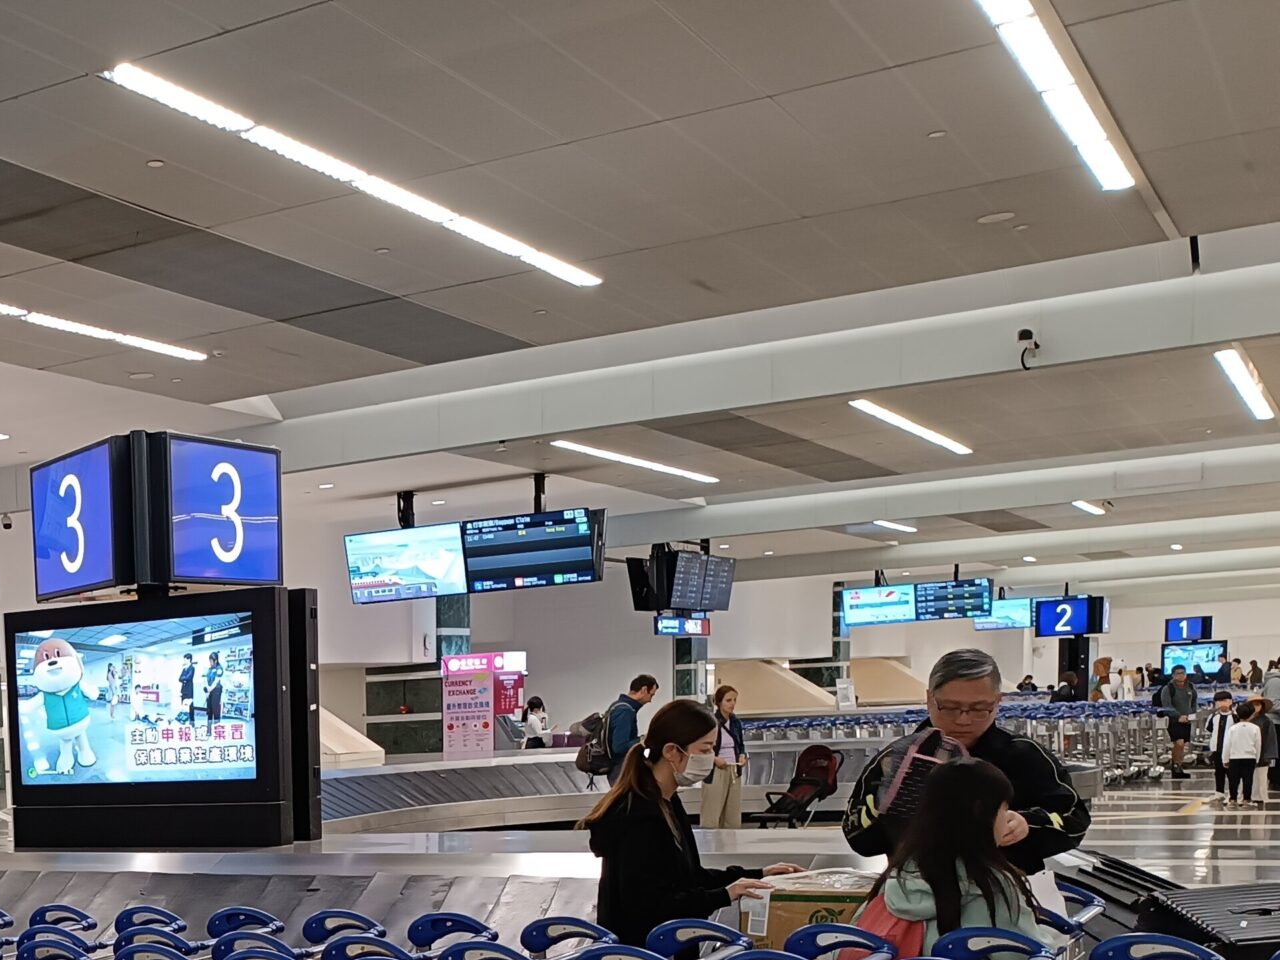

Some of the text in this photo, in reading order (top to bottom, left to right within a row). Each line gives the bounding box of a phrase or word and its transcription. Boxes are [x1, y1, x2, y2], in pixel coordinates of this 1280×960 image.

[58, 473, 85, 574] 3
[209, 462, 245, 564] 3
[1054, 603, 1072, 632] 2
[1179, 619, 1188, 639] 1
[444, 679, 473, 688] CURRENCY
[448, 688, 477, 696] EXCHANGE
